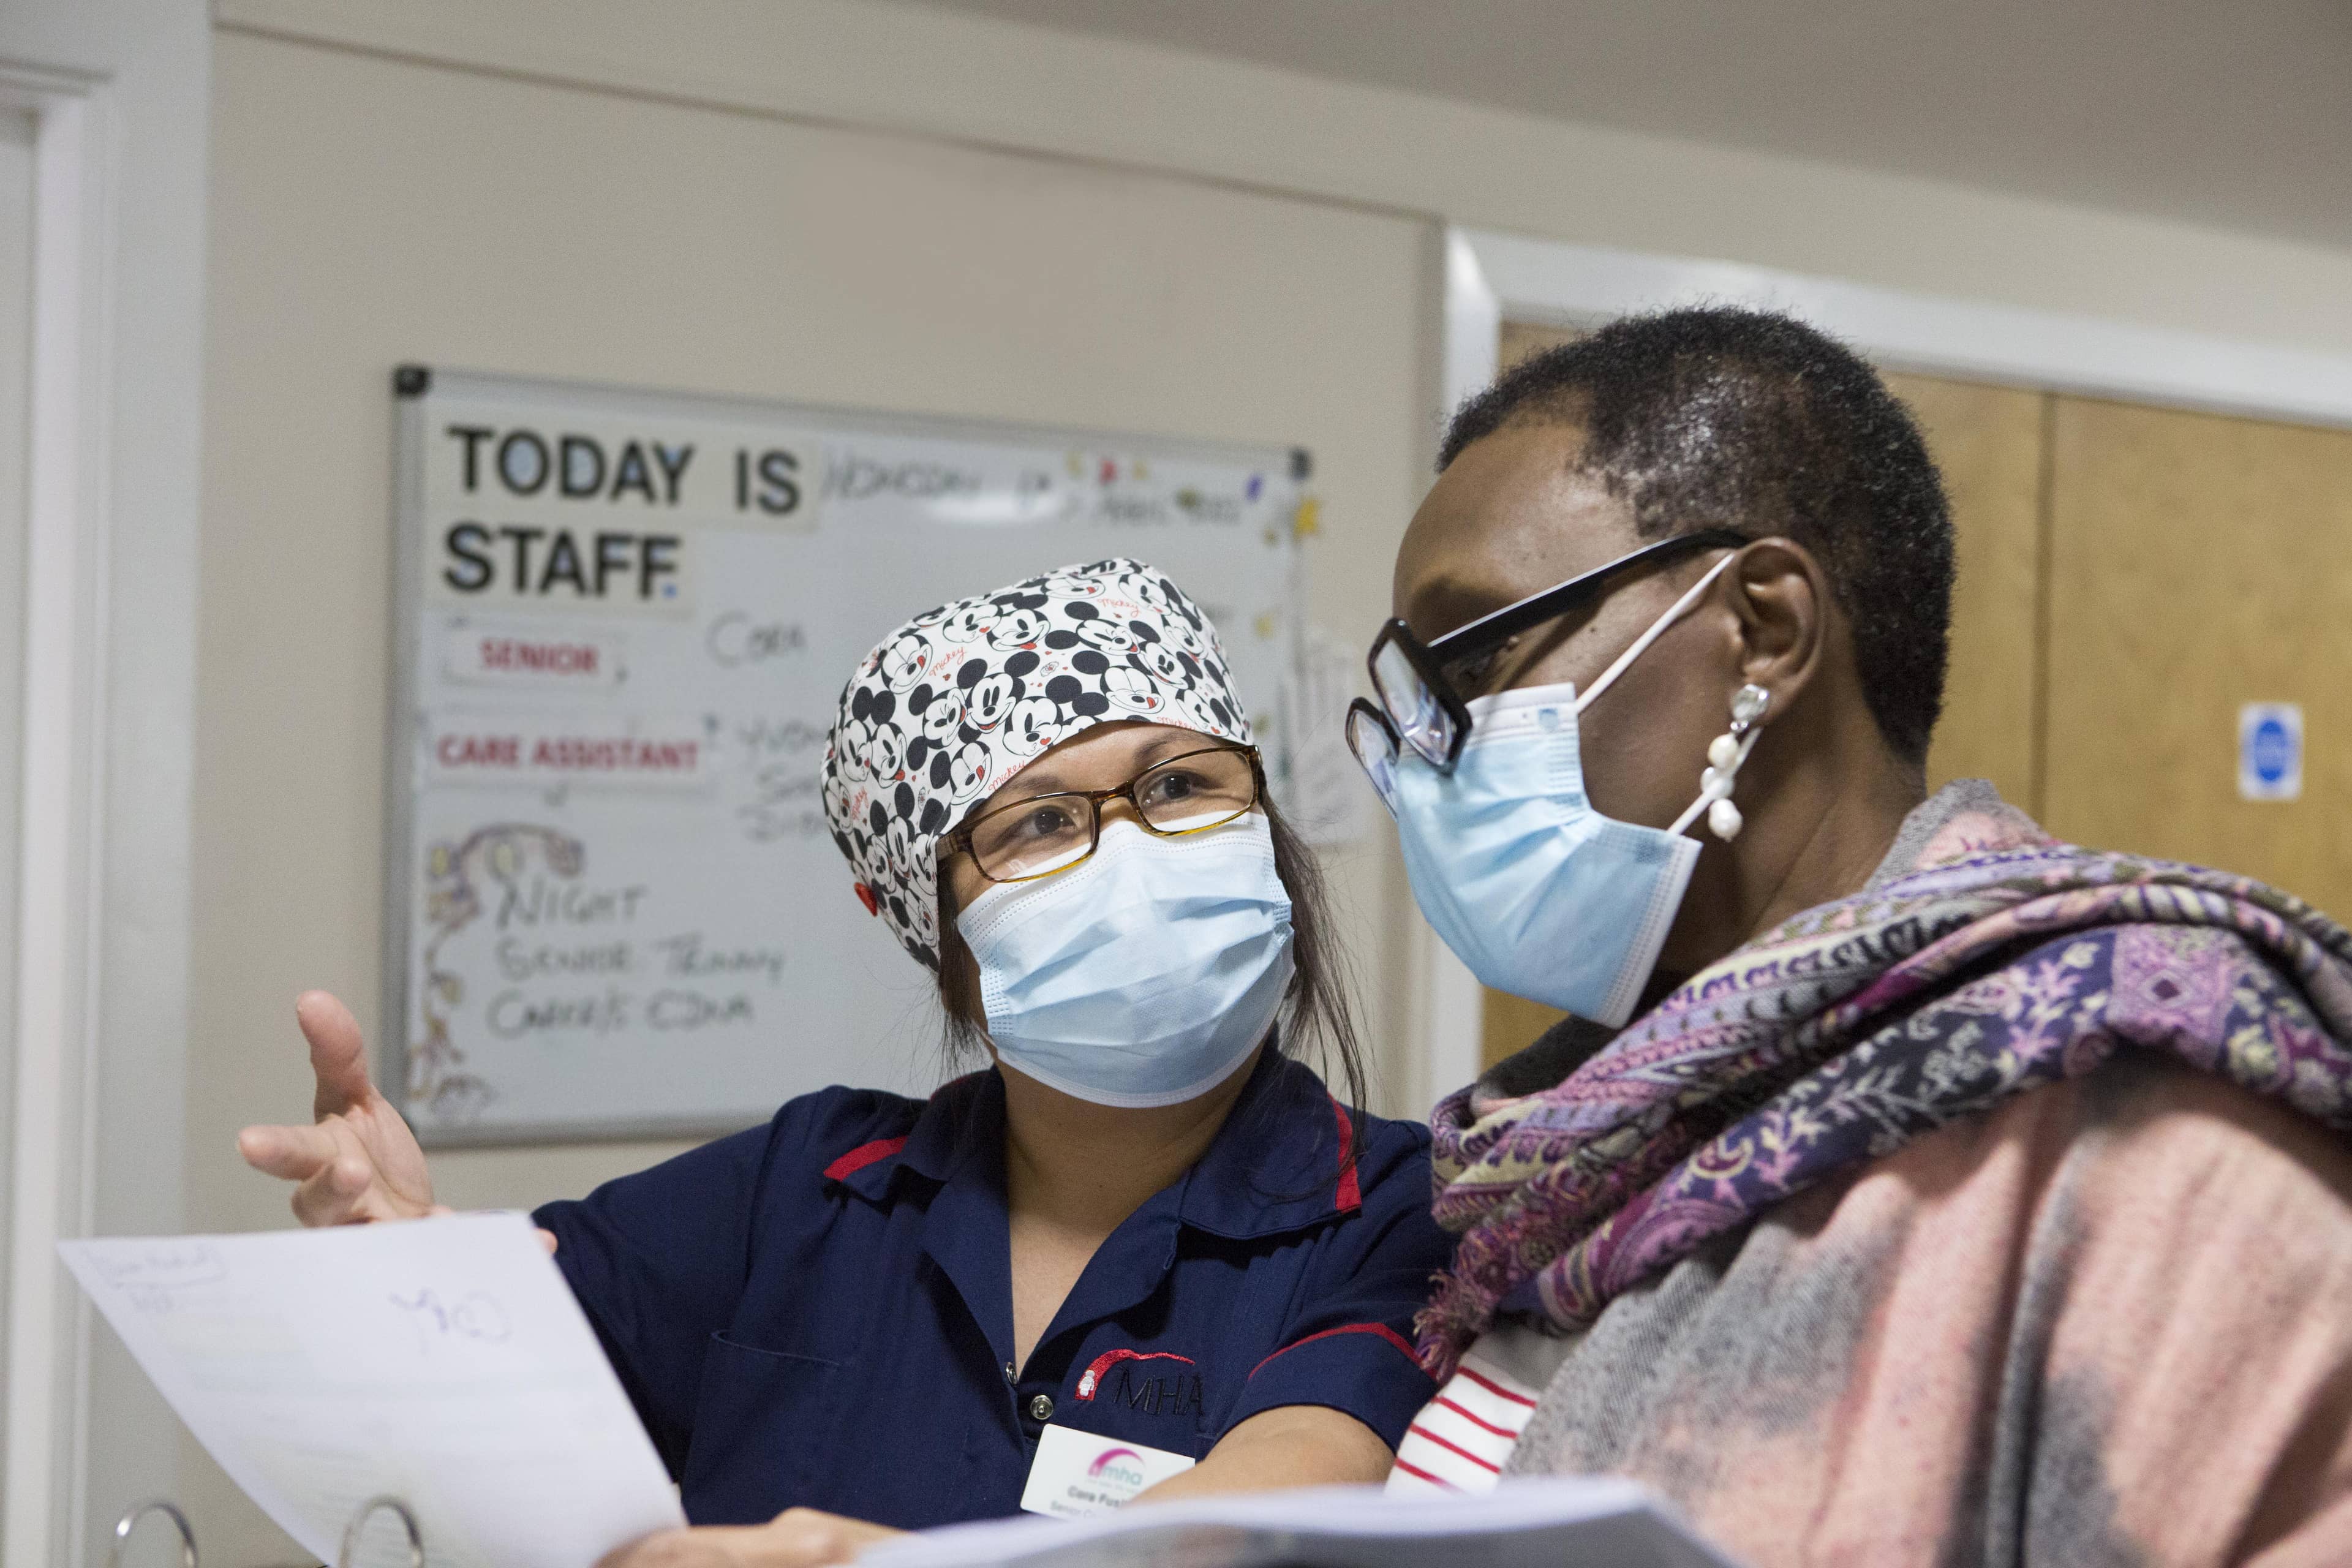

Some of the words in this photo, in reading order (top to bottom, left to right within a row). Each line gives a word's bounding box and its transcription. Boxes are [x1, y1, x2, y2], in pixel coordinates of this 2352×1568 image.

[446, 424, 695, 503] TODAY
[735, 448, 801, 515] IS
[443, 521, 680, 600] STAFF
[1098, 598, 1140, 618] Mickey
[481, 639, 599, 673] SENIOR
[929, 647, 966, 676] Mickey
[438, 736, 519, 767] CARE
[533, 739, 699, 770] ASSISTANT
[1113, 1365, 1205, 1417] MHA
[1103, 1465, 1143, 1485] mha
[1099, 1493, 1127, 1508] Fus
